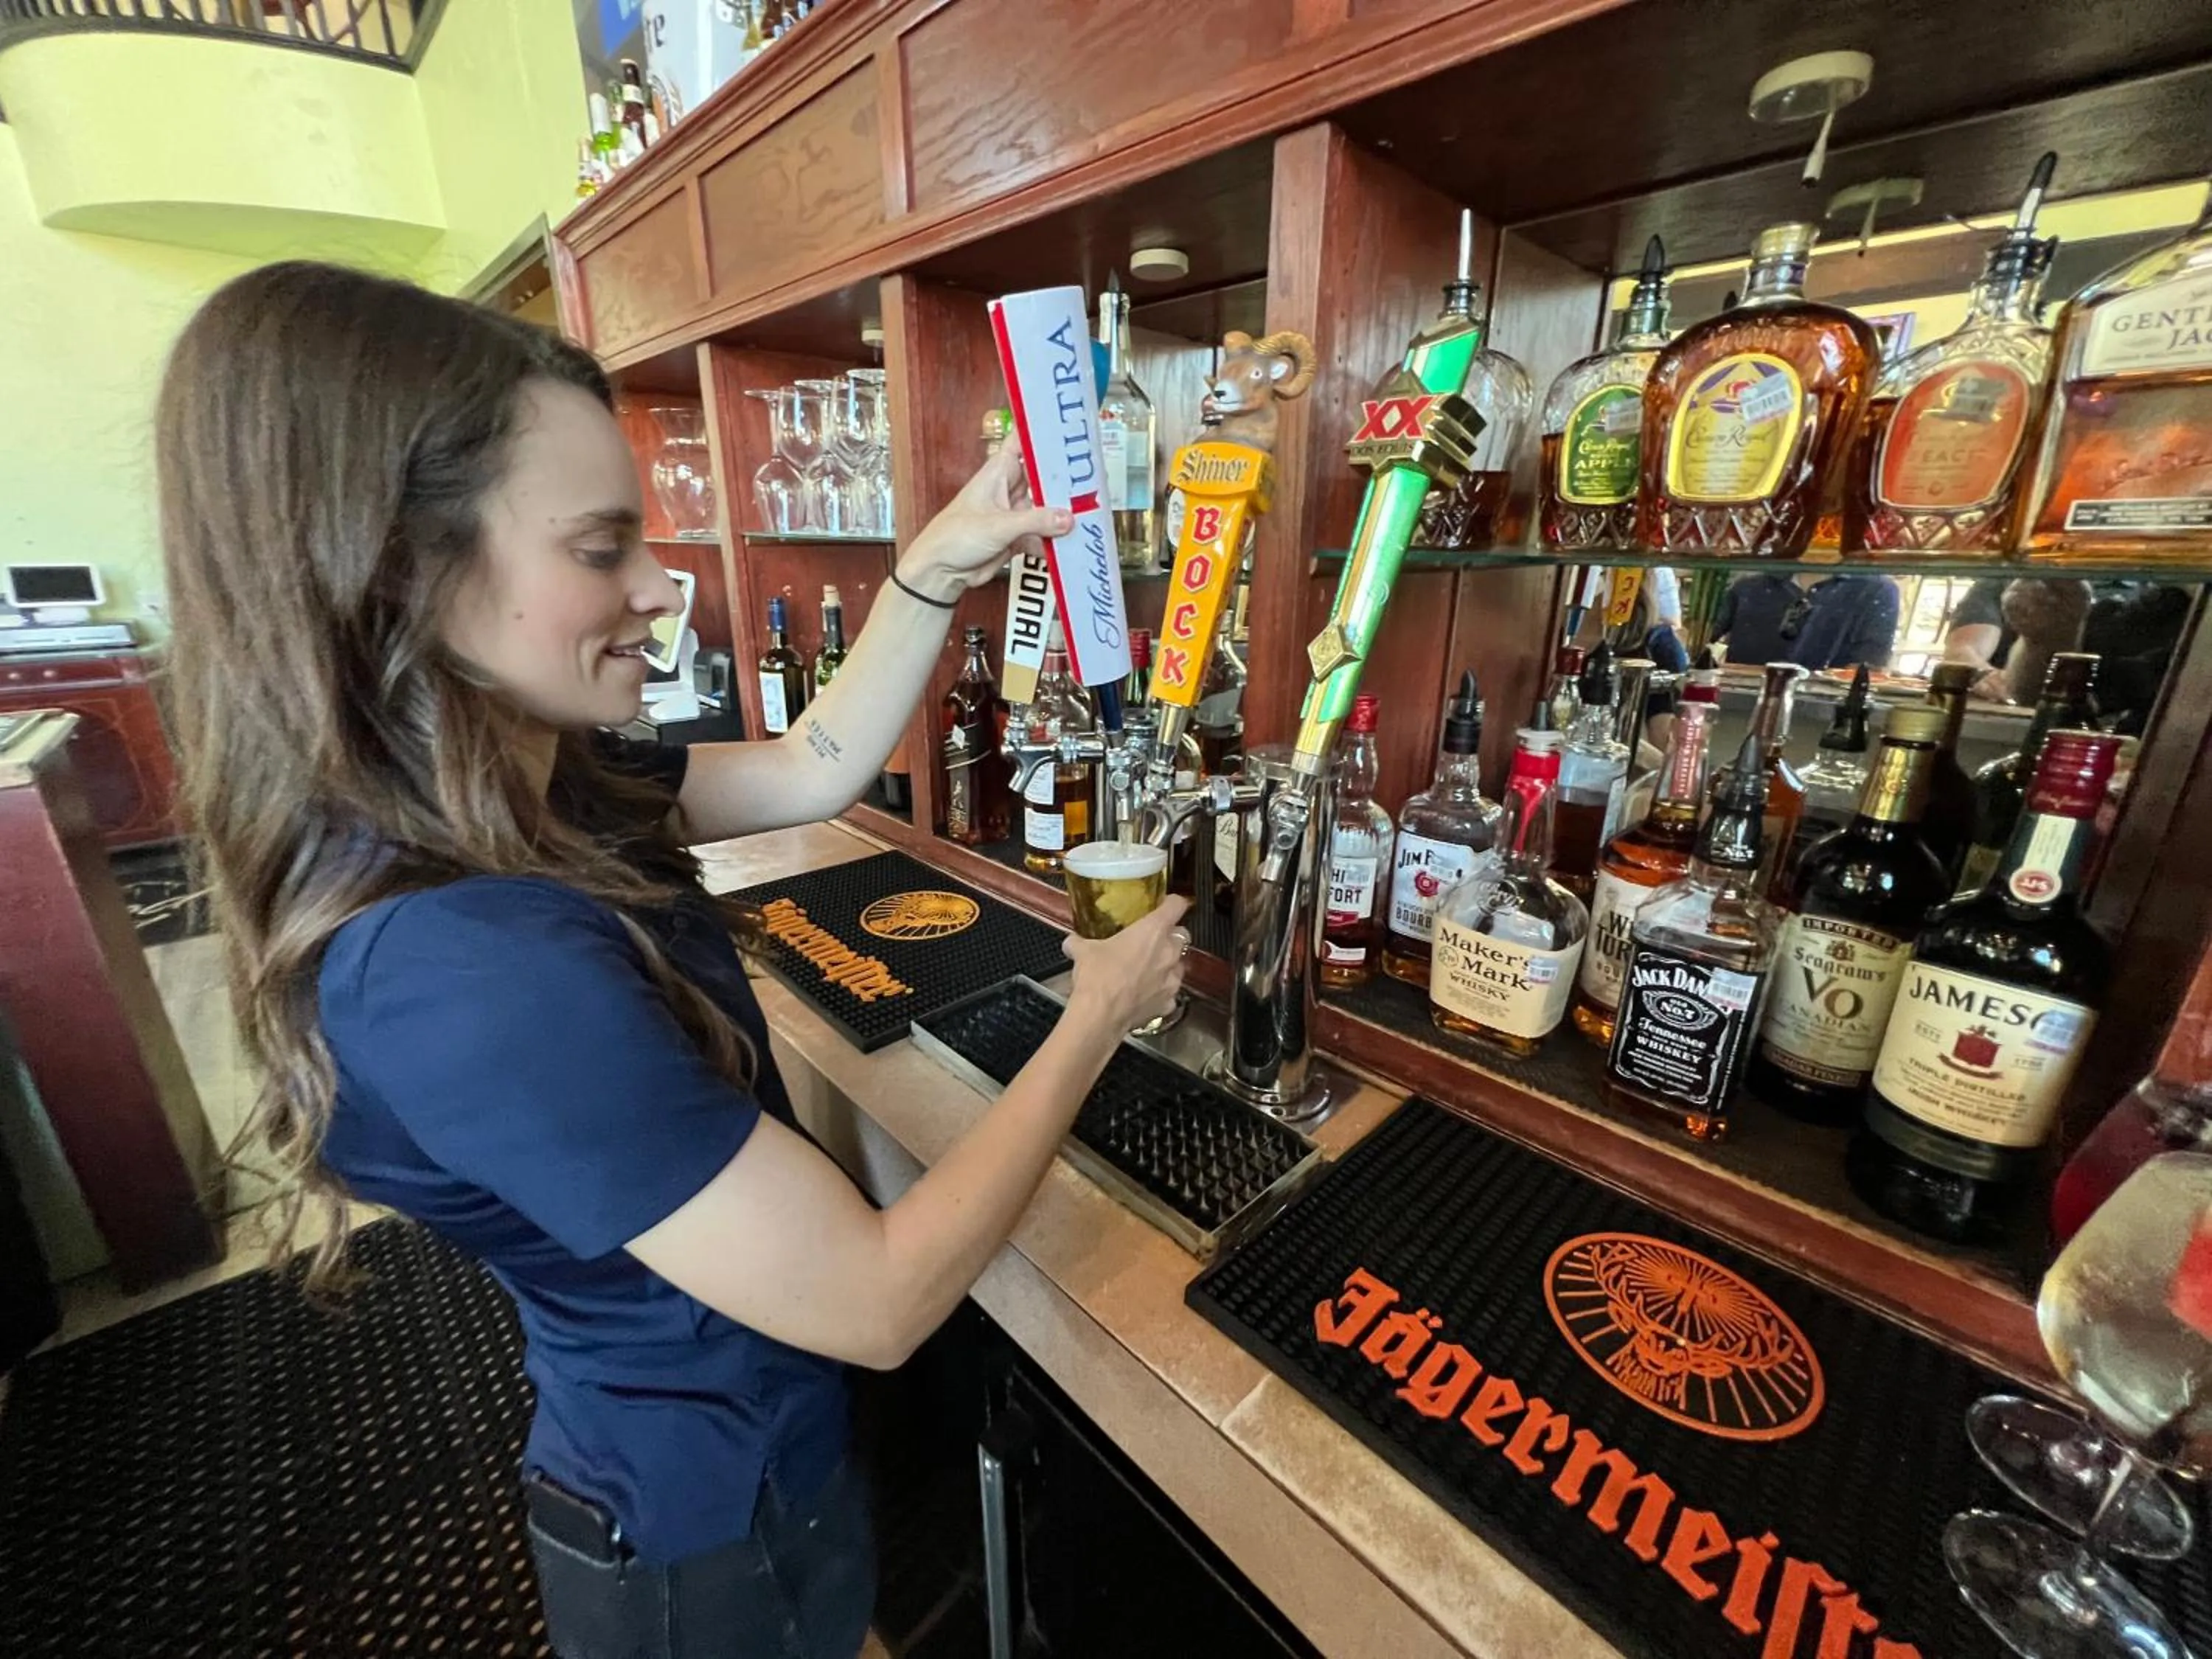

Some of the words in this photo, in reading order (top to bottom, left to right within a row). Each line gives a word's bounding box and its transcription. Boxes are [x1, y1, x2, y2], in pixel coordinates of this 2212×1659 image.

[1046, 315, 1095, 489] ULTRA
[1353, 395, 1436, 443] XX
[1178, 448, 1249, 484] Shiner
[1081, 521, 1121, 650] Michelob
[1160, 504, 1222, 689] BOCK
[1009, 554, 1049, 655] SONAL
[1397, 849, 1422, 869] JIM
[1396, 907, 1433, 929] BOURB
[1596, 923, 1632, 960] TUR
[1461, 955, 1531, 992] Mark
[1631, 964, 1671, 987] JACK
[1910, 975, 2047, 1031] JAMES
[1636, 1035, 1703, 1065] WHISKEY
[1638, 1017, 1707, 1048] Tennessee
[1313, 1266, 1923, 1659] Jägermeist
